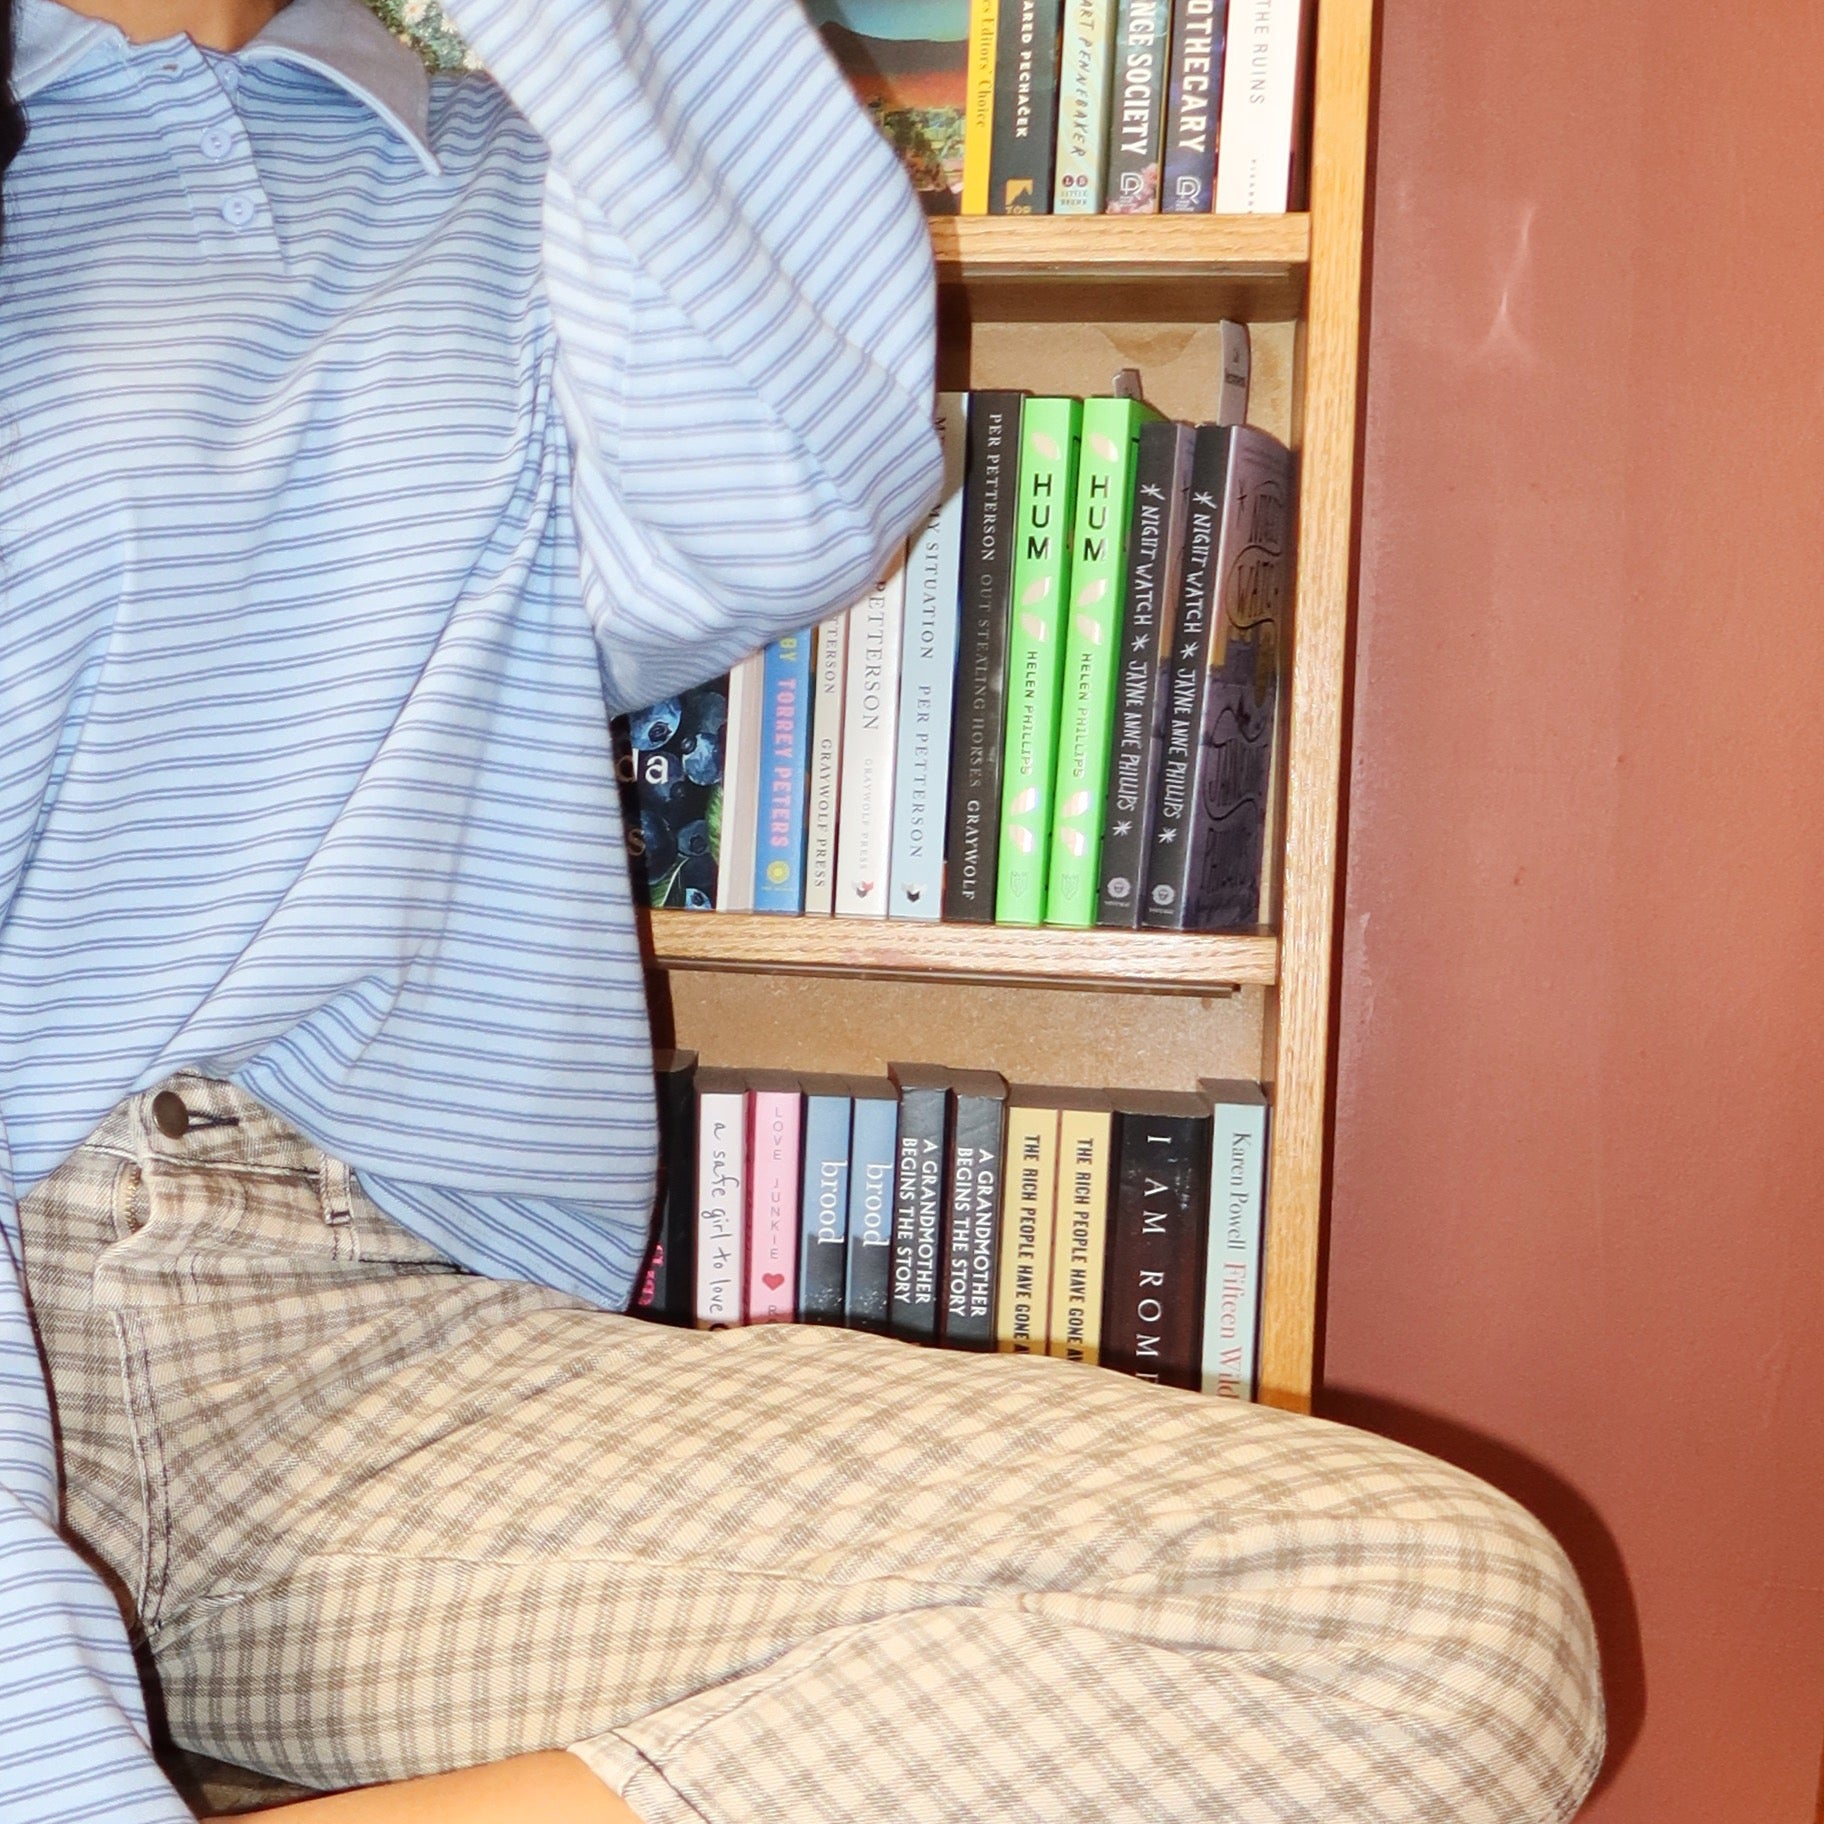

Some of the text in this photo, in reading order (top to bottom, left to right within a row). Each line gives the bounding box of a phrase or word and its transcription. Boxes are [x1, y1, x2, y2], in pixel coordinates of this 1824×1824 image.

[1026, 474, 1053, 561] HUM
[770, 678, 798, 849] TORREY PETERS
[817, 1160, 847, 1245] brood
[1014, 1164, 1038, 1342] RICH PEOPLE HAVE GONE
